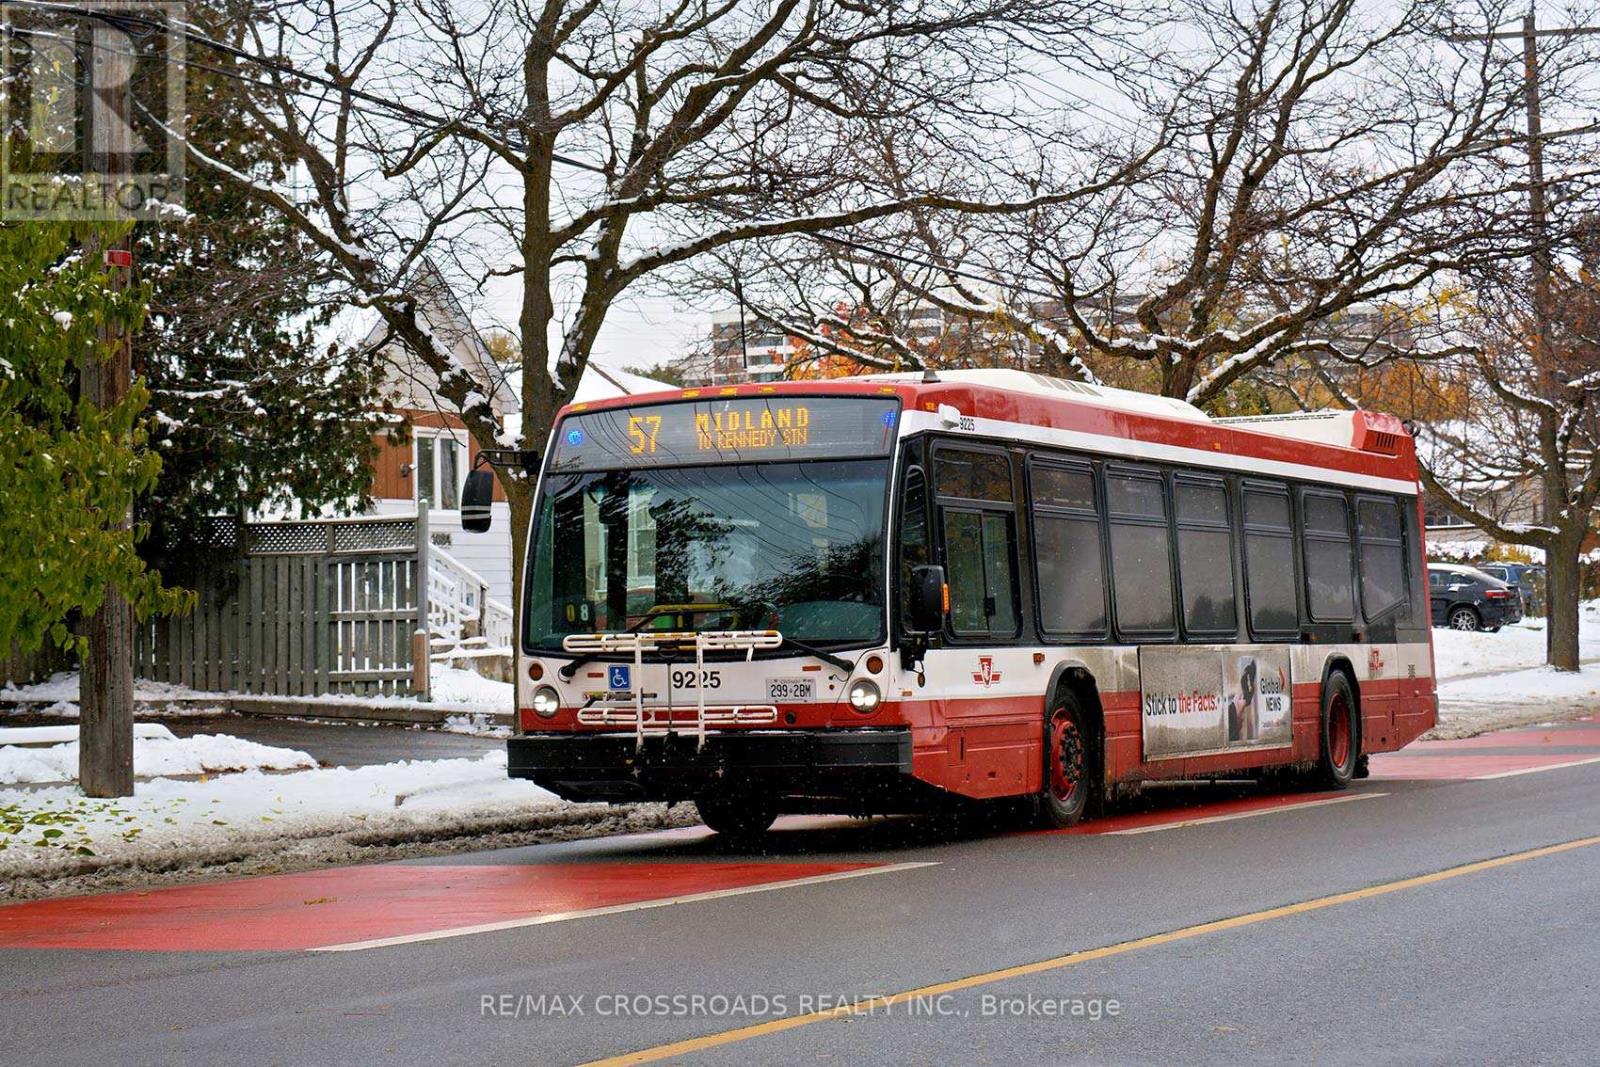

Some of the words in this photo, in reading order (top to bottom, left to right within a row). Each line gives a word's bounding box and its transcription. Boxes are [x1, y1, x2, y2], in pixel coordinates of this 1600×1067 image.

[695, 407, 809, 431] MIDLAND
[959, 416, 975, 431] 9225
[628, 415, 662, 455] 57
[698, 431, 712, 449] TO
[717, 429, 777, 449] KENNEDY
[782, 427, 807, 446] STN
[672, 670, 721, 689] 9225
[1260, 676, 1281, 695] Global
[1145, 692, 1167, 717] Stick
[1168, 694, 1177, 715] to
[1178, 690, 1192, 713] the
[1265, 696, 1281, 712] NEWS
